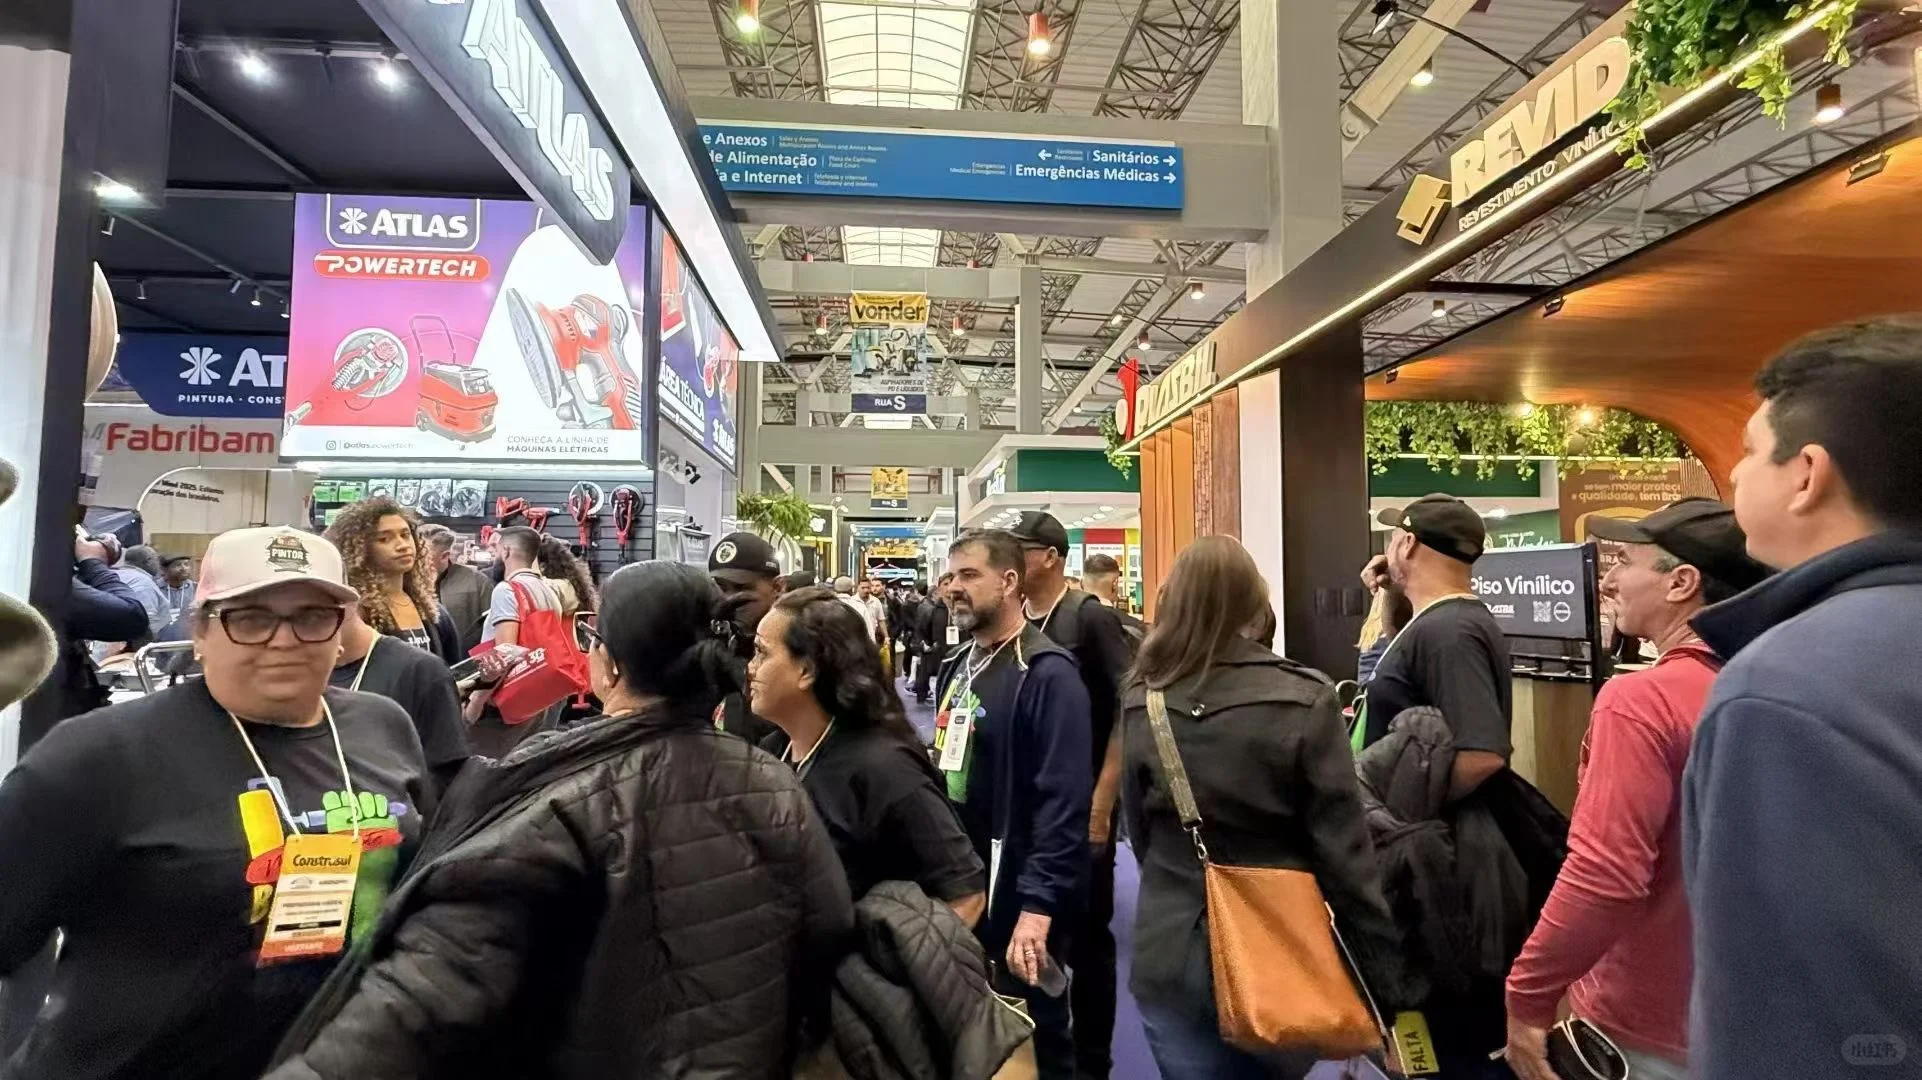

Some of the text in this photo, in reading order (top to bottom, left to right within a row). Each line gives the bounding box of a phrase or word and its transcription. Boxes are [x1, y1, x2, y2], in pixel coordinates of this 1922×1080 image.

[461, 0, 614, 220] ATLAS
[1450, 36, 1630, 208] REVID
[702, 132, 768, 147] e Anexos
[727, 151, 817, 168] Alimentação
[1092, 150, 1159, 165] Sanitários
[732, 172, 740, 182] e
[745, 170, 803, 184] Internet
[1016, 164, 1160, 182] Emergências Médicas
[1459, 160, 1557, 232] REVESTIMENTO
[371, 208, 469, 239] ATLAS
[315, 253, 478, 278] POWERTECH
[178, 394, 234, 403] PINTURA
[874, 395, 906, 410] RUA S
[106, 422, 275, 454] Fabribam
[507, 436, 609, 444] CONHEÇA A LINHA DE
[560, 445, 609, 453] ELÉTRICAS
[1612, 482, 1640, 491] maior
[272, 548, 304, 560] PINTOR
[1504, 574, 1575, 595] Vinílico
[1404, 1031, 1429, 1072] FALTA
